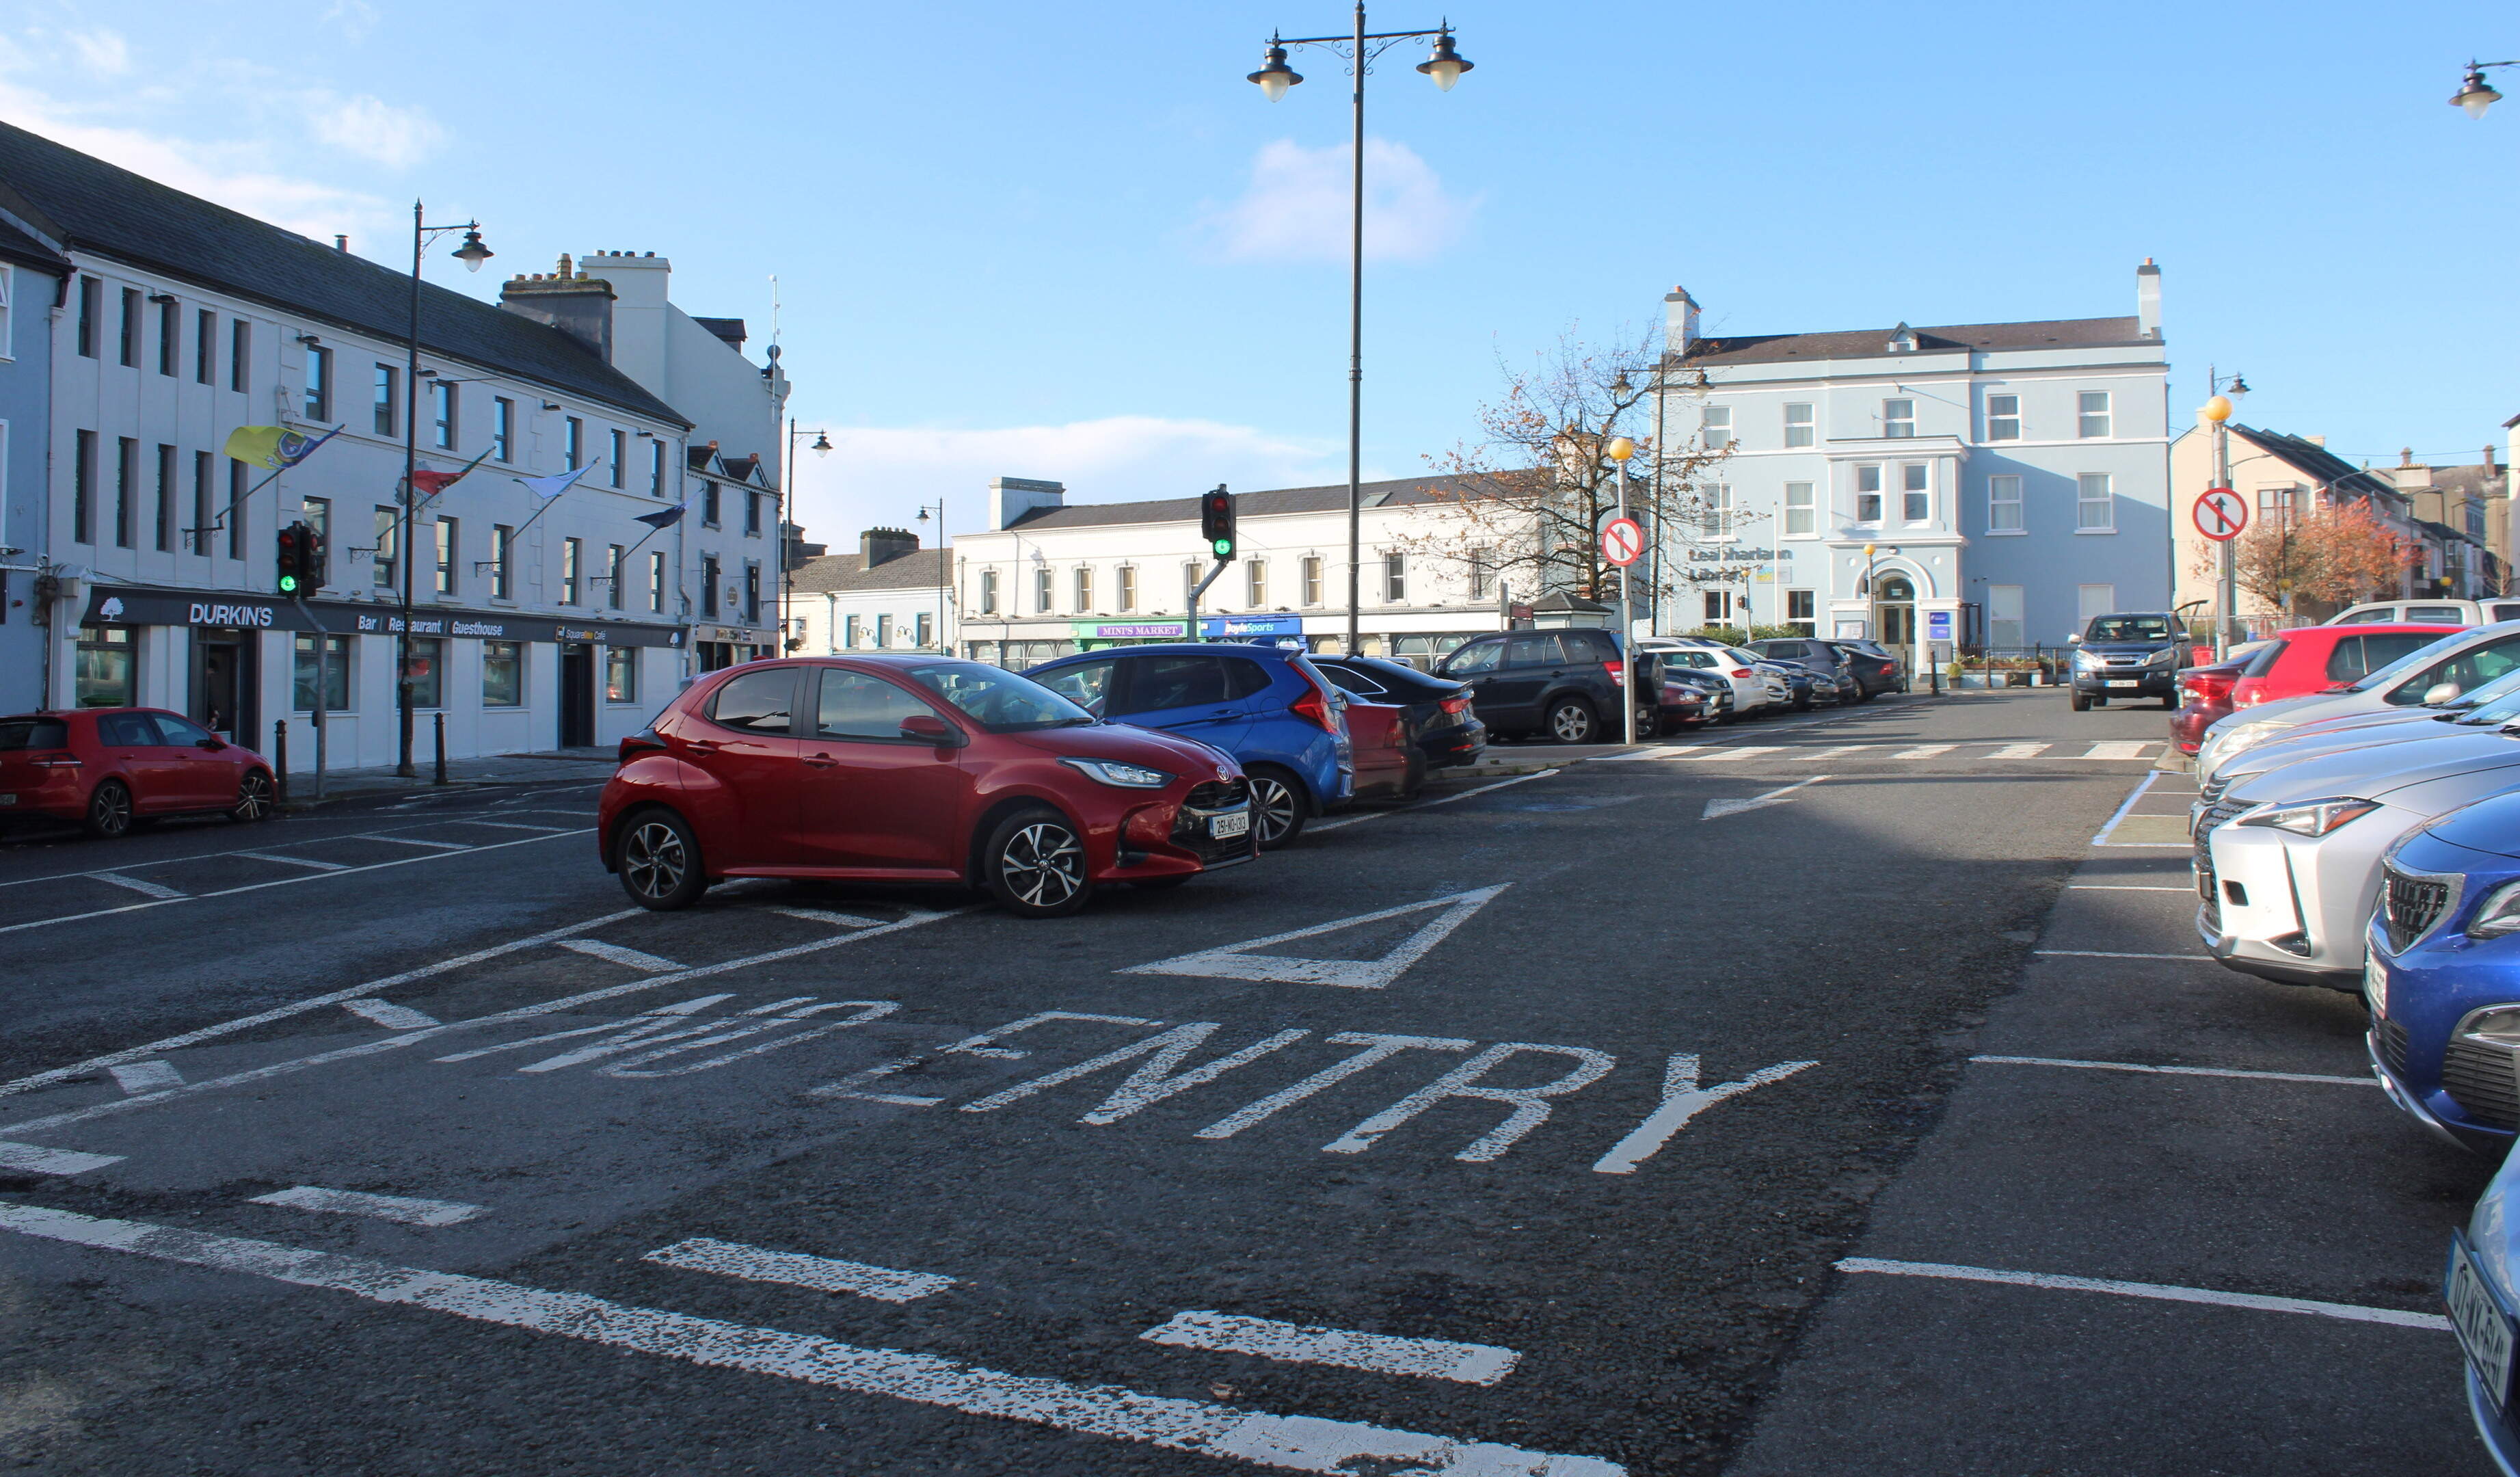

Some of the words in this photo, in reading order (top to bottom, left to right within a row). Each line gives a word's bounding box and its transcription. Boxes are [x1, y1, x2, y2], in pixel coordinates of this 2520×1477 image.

[189, 603, 273, 627] DURKIN'S
[358, 615, 377, 630] Bar
[388, 617, 442, 634] Resaurant
[452, 620, 503, 637] Guesthouse
[1103, 627, 1134, 636] MINI'S
[1136, 626, 1178, 635] MARKET
[1224, 622, 1274, 635] BoyleSports
[433, 993, 902, 1078] NO
[805, 1010, 1821, 1175] ENTRY
